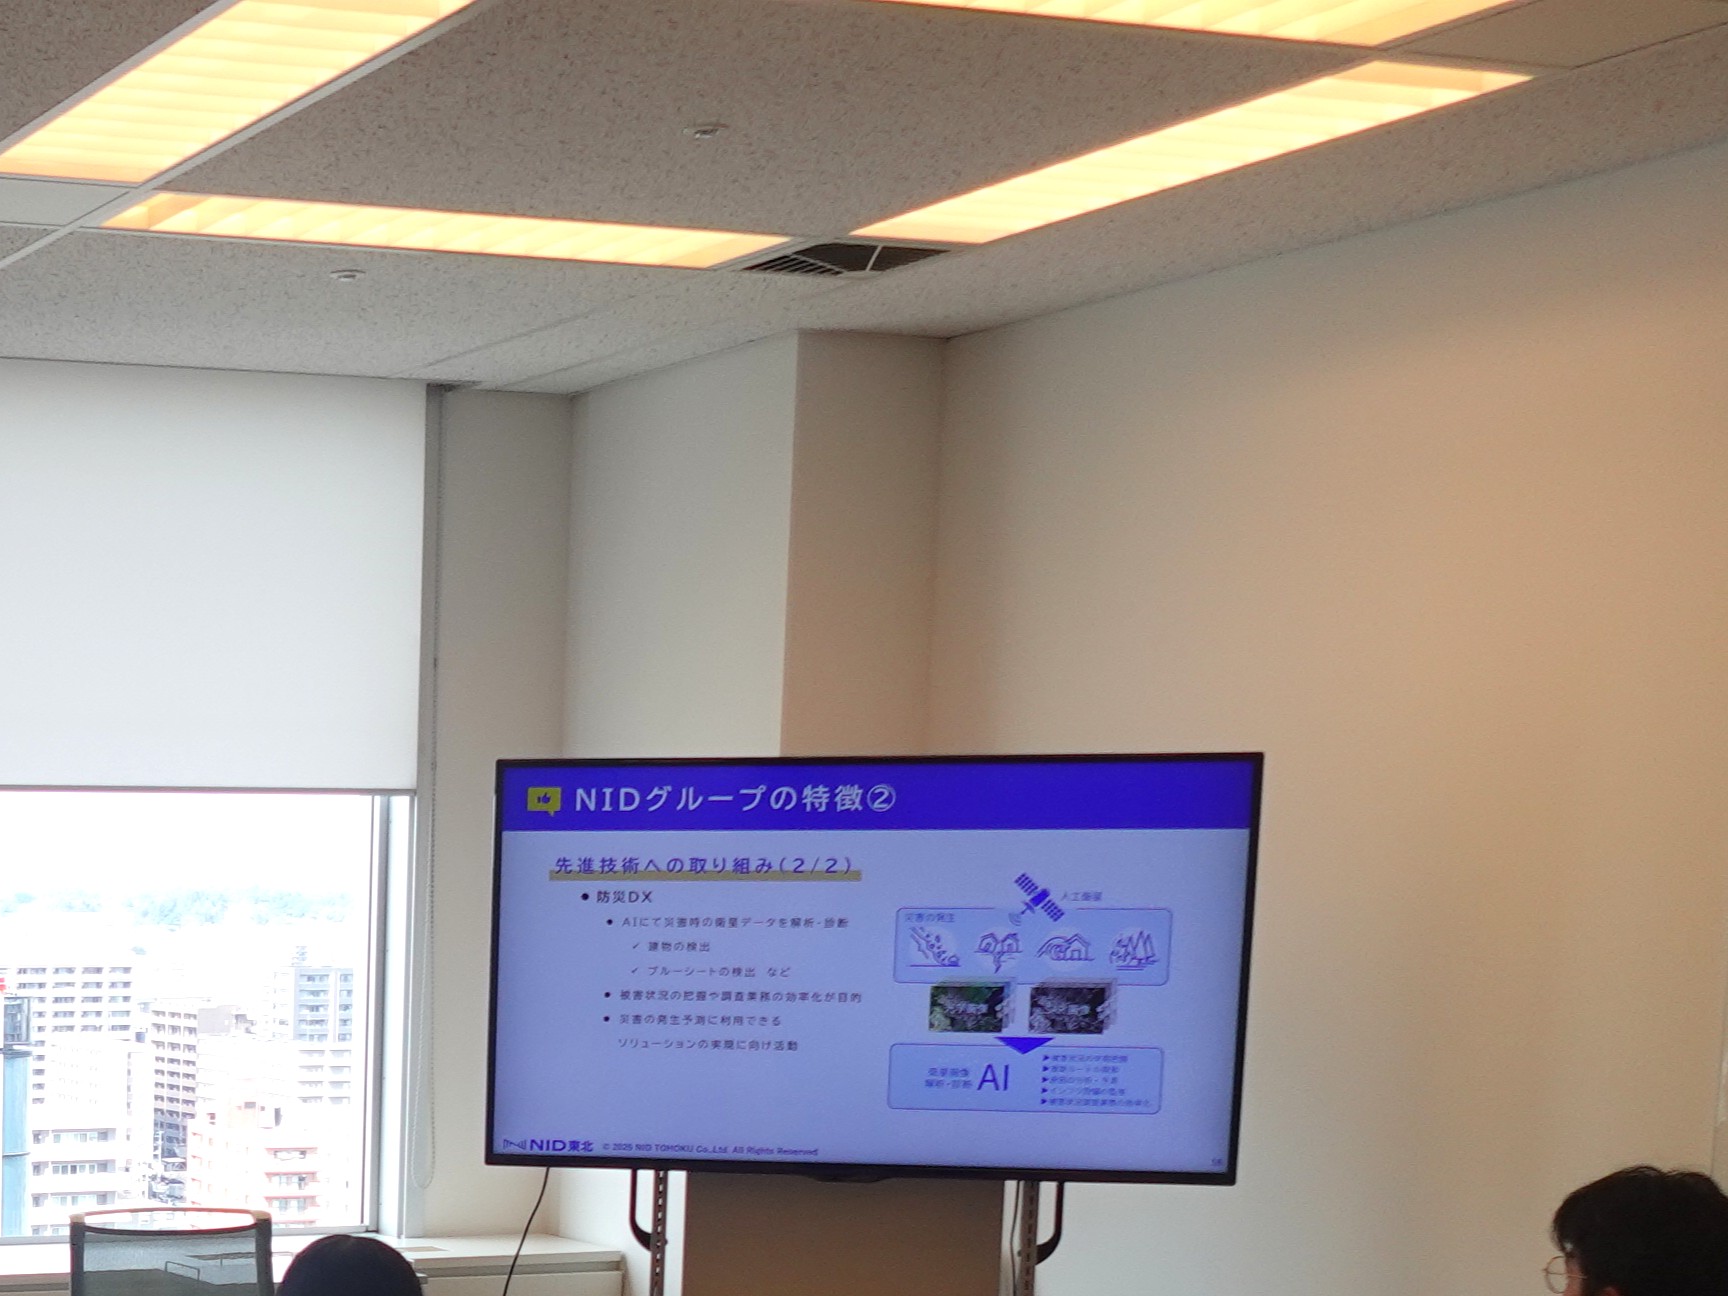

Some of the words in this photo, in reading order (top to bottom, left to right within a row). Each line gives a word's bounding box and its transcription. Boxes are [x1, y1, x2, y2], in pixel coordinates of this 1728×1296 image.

[574, 783, 897, 814] NIDグループの特徴②
[596, 890, 653, 904] 防災DX
[648, 941, 711, 953] 建物の検出
[767, 966, 791, 978] など
[619, 1014, 782, 1027] 災害の発生予測に利用できる
[618, 1038, 799, 1052] ソリューションの実現に向け活動
[976, 1063, 1010, 1092] AI
[530, 1139, 593, 1152] NID東北
